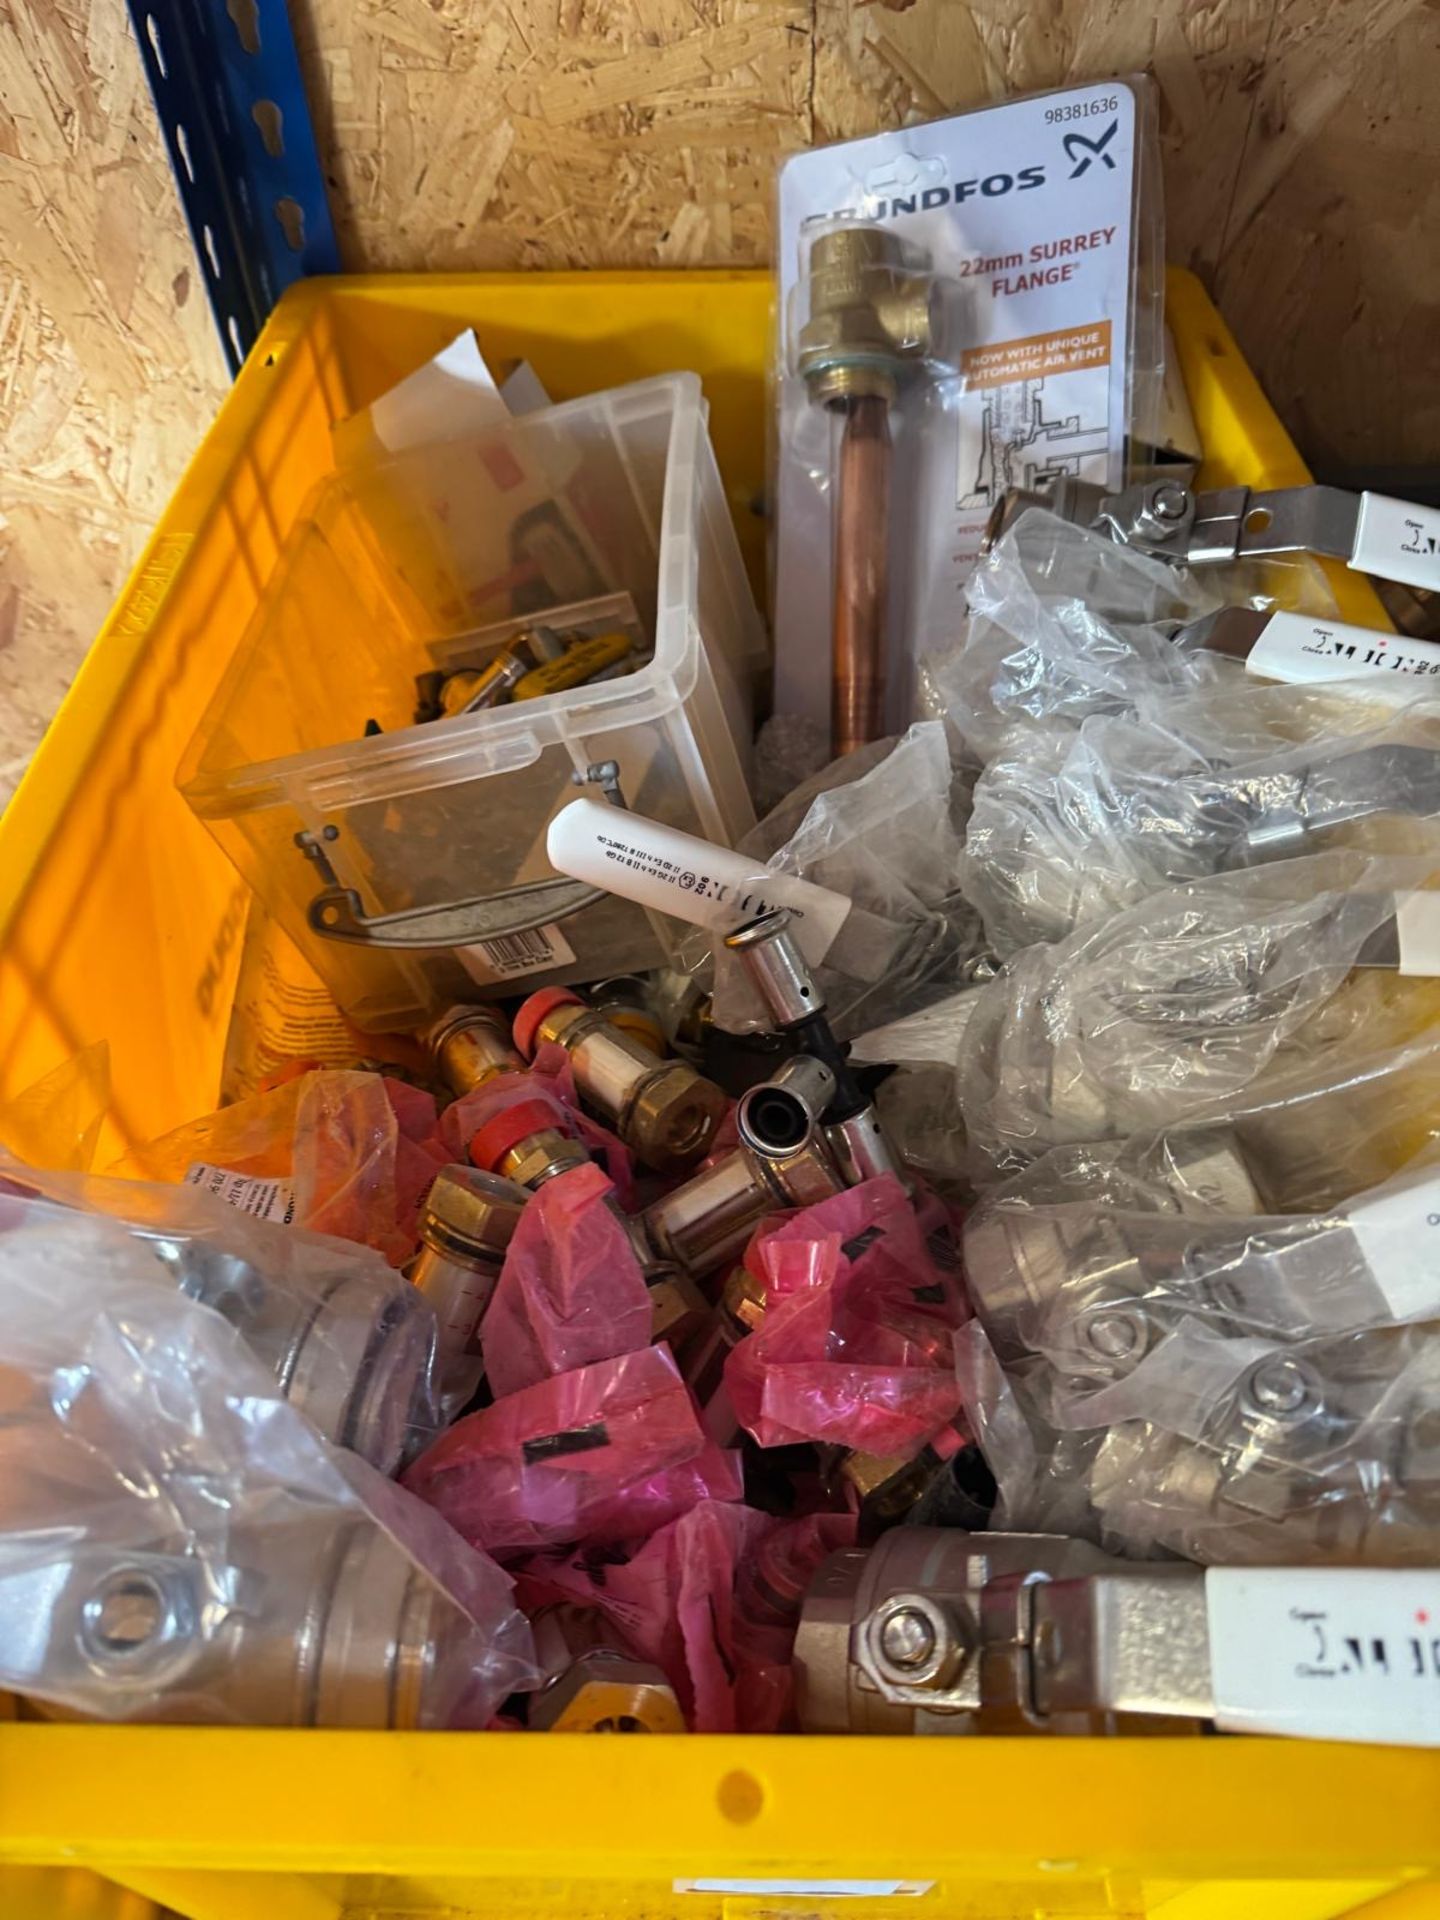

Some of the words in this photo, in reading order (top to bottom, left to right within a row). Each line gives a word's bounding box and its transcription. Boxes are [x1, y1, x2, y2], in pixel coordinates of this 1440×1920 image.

[1044, 96, 1118, 124] 98381636
[960, 253, 1023, 278] 22mm
[1029, 226, 1117, 263] SURREY
[970, 352, 1004, 368] NOW
[1007, 344, 1043, 359] WITH
[1046, 332, 1100, 352] UNIQUE
[1043, 354, 1066, 368] AIR
[1069, 346, 1106, 363] VENT
